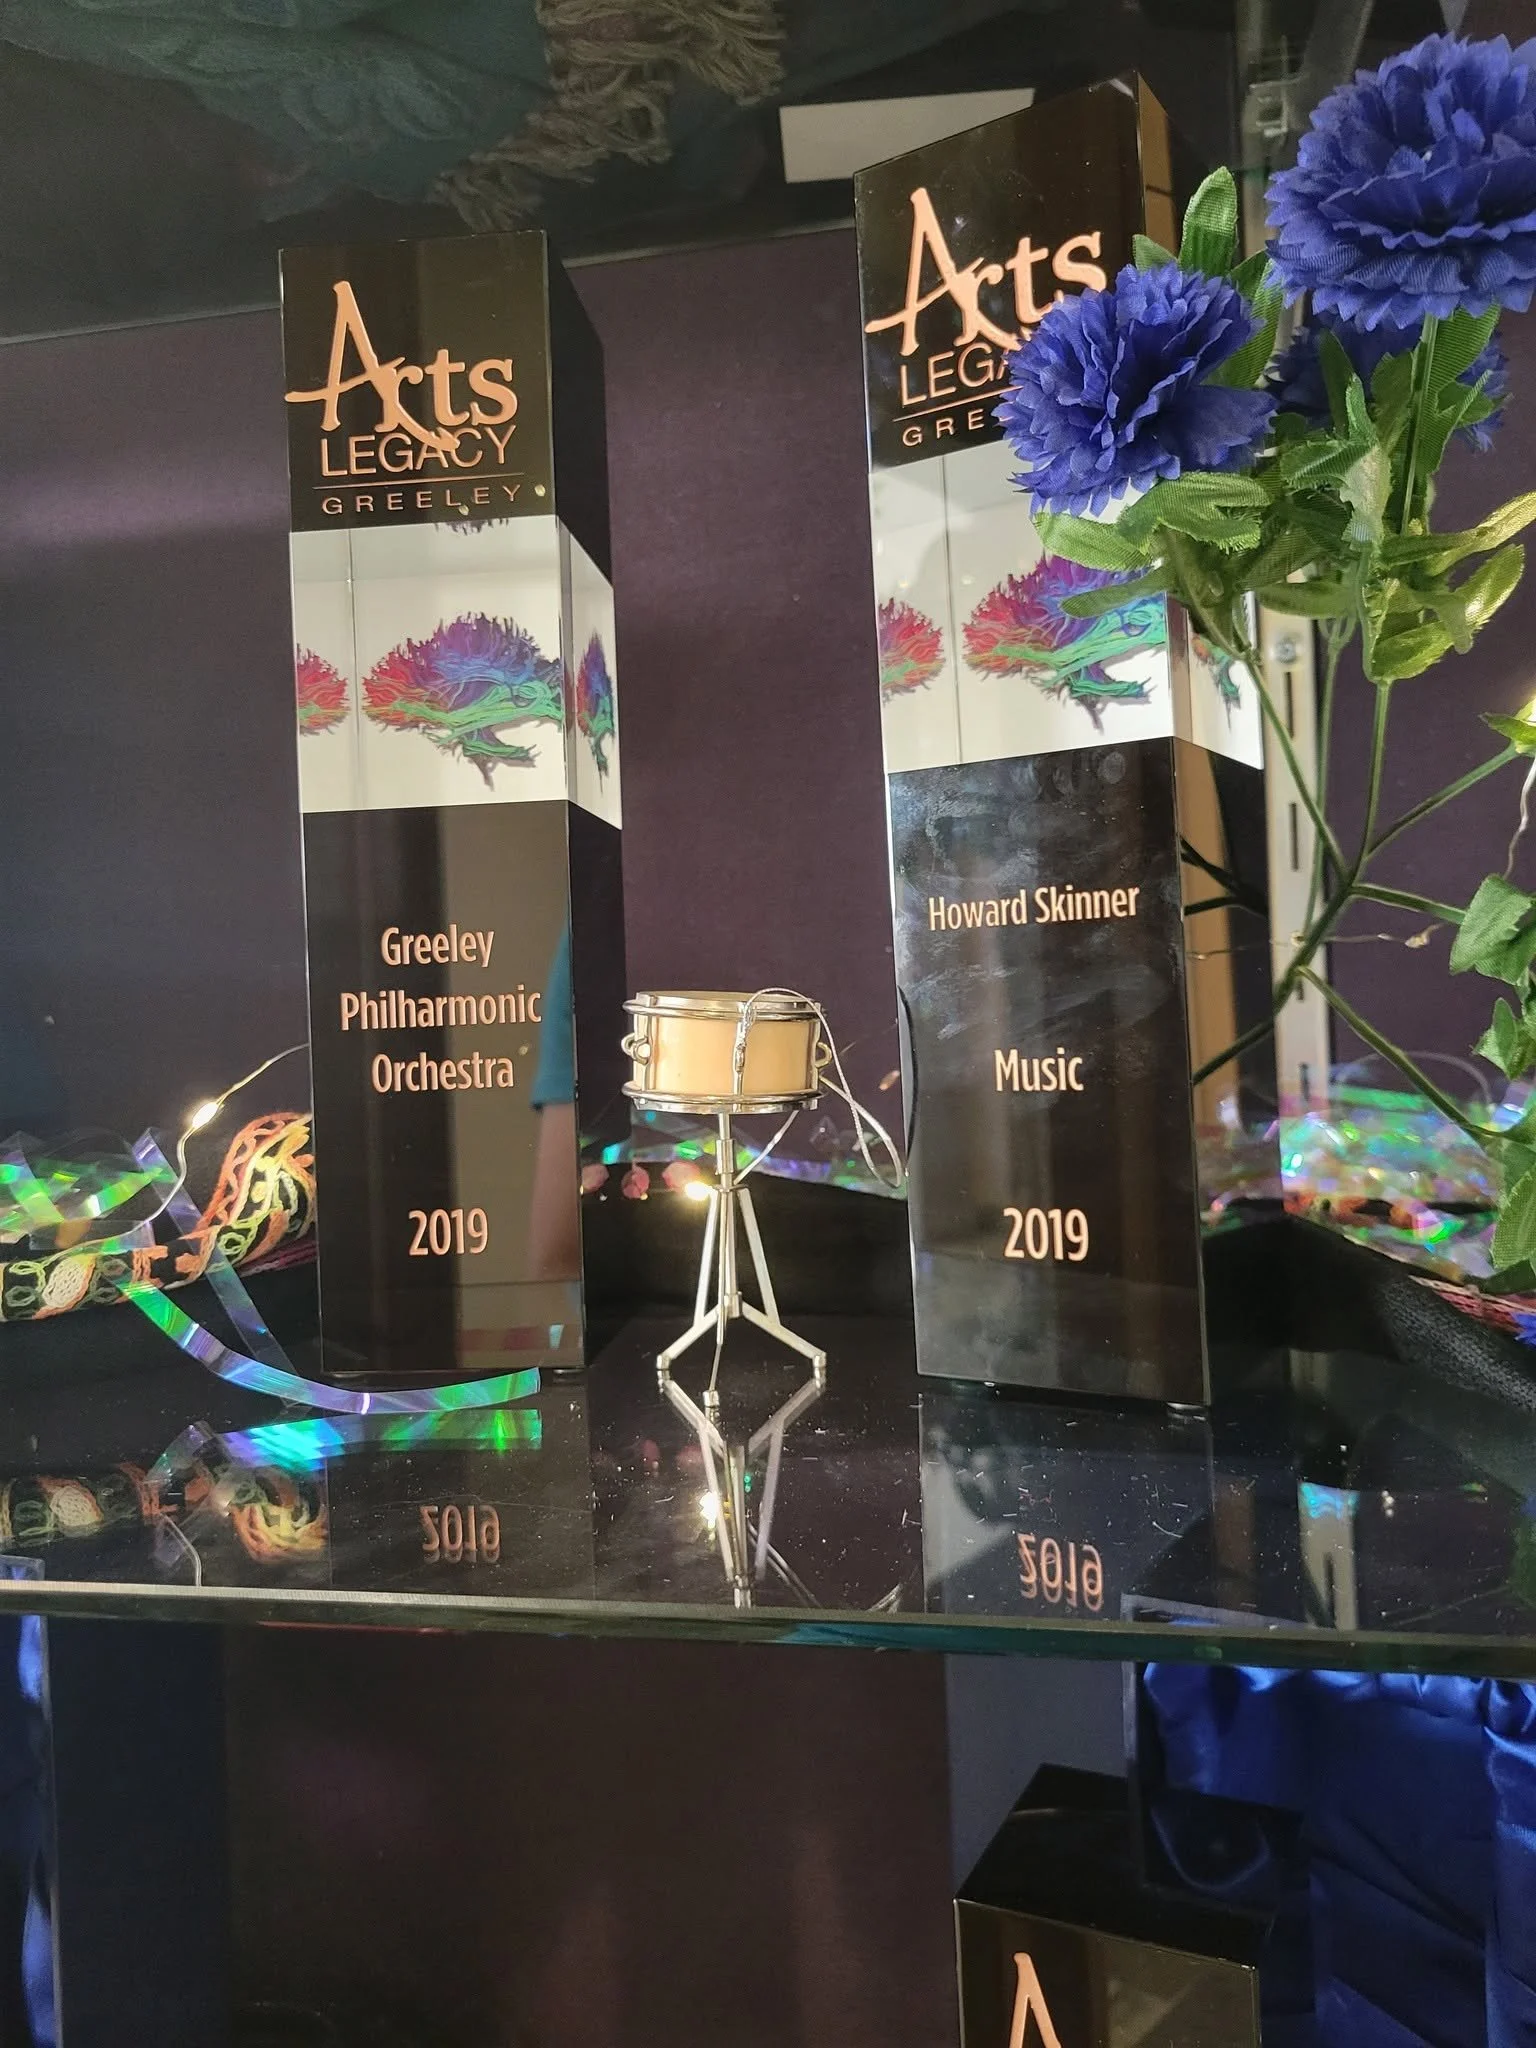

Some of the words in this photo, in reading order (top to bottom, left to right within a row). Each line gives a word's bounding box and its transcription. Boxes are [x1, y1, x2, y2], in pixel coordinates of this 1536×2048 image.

[865, 187, 1107, 356] Arts
[284, 280, 518, 446] Arts
[901, 341, 1010, 408] LEG
[320, 425, 516, 476] LEGACY
[322, 484, 521, 515] GREELEY
[928, 888, 1028, 931] Howard
[1035, 885, 1141, 924] Skinner
[381, 924, 495, 967] Greeley
[340, 984, 542, 1031] Philharmonic
[371, 1051, 514, 1093] Orchestra
[994, 1047, 1085, 1092] Music
[408, 1208, 489, 1257] 2019
[1003, 1207, 1090, 1261] 2019
